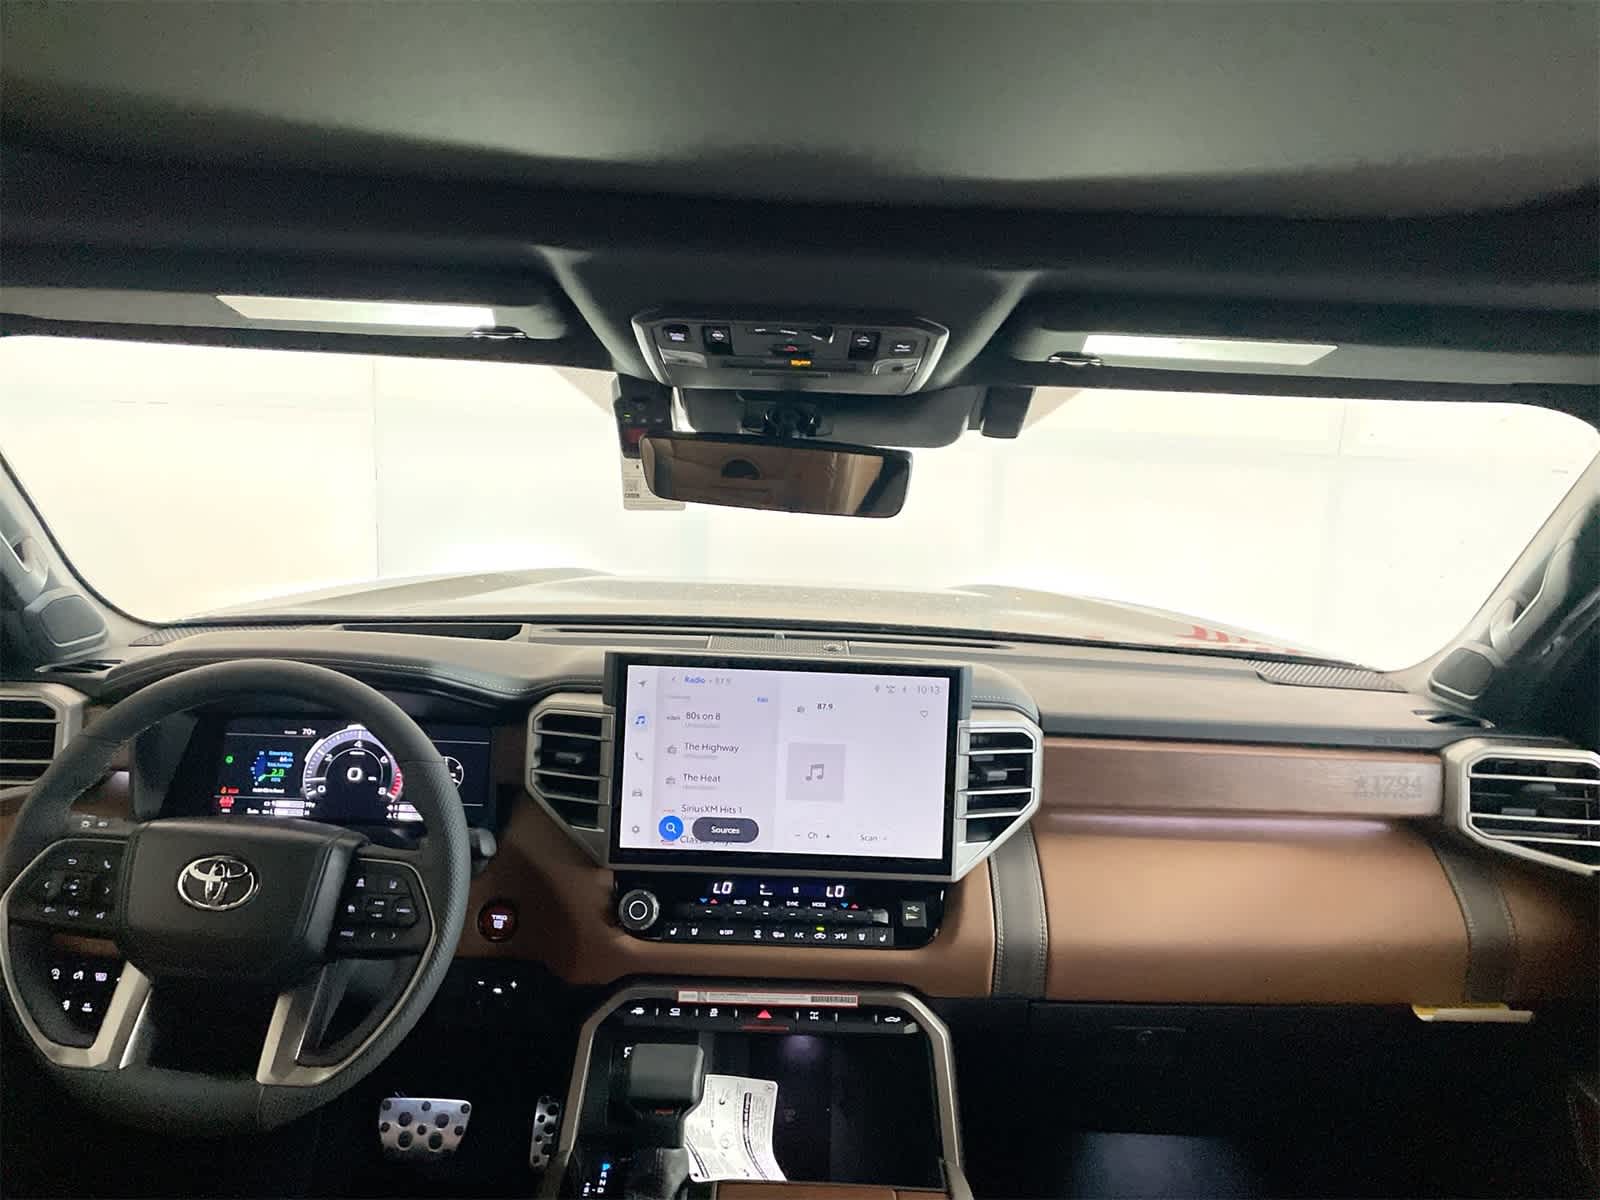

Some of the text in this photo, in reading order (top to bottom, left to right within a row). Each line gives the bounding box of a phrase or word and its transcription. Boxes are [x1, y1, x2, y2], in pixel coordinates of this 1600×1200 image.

[816, 702, 834, 711] 87.9
[685, 711, 700, 721] 80s
[702, 713, 713, 721] on
[715, 712, 721, 721] 8
[684, 742, 740, 754] The Highway
[380, 756, 388, 764] 6
[682, 773, 721, 784] The Heat
[317, 785, 326, 793] 0
[378, 787, 387, 795] 8
[681, 803, 718, 814] SiriusXM
[719, 806, 737, 815] Hits
[711, 824, 740, 836] Sources
[807, 831, 818, 840] Ch
[859, 833, 878, 842] Scan
